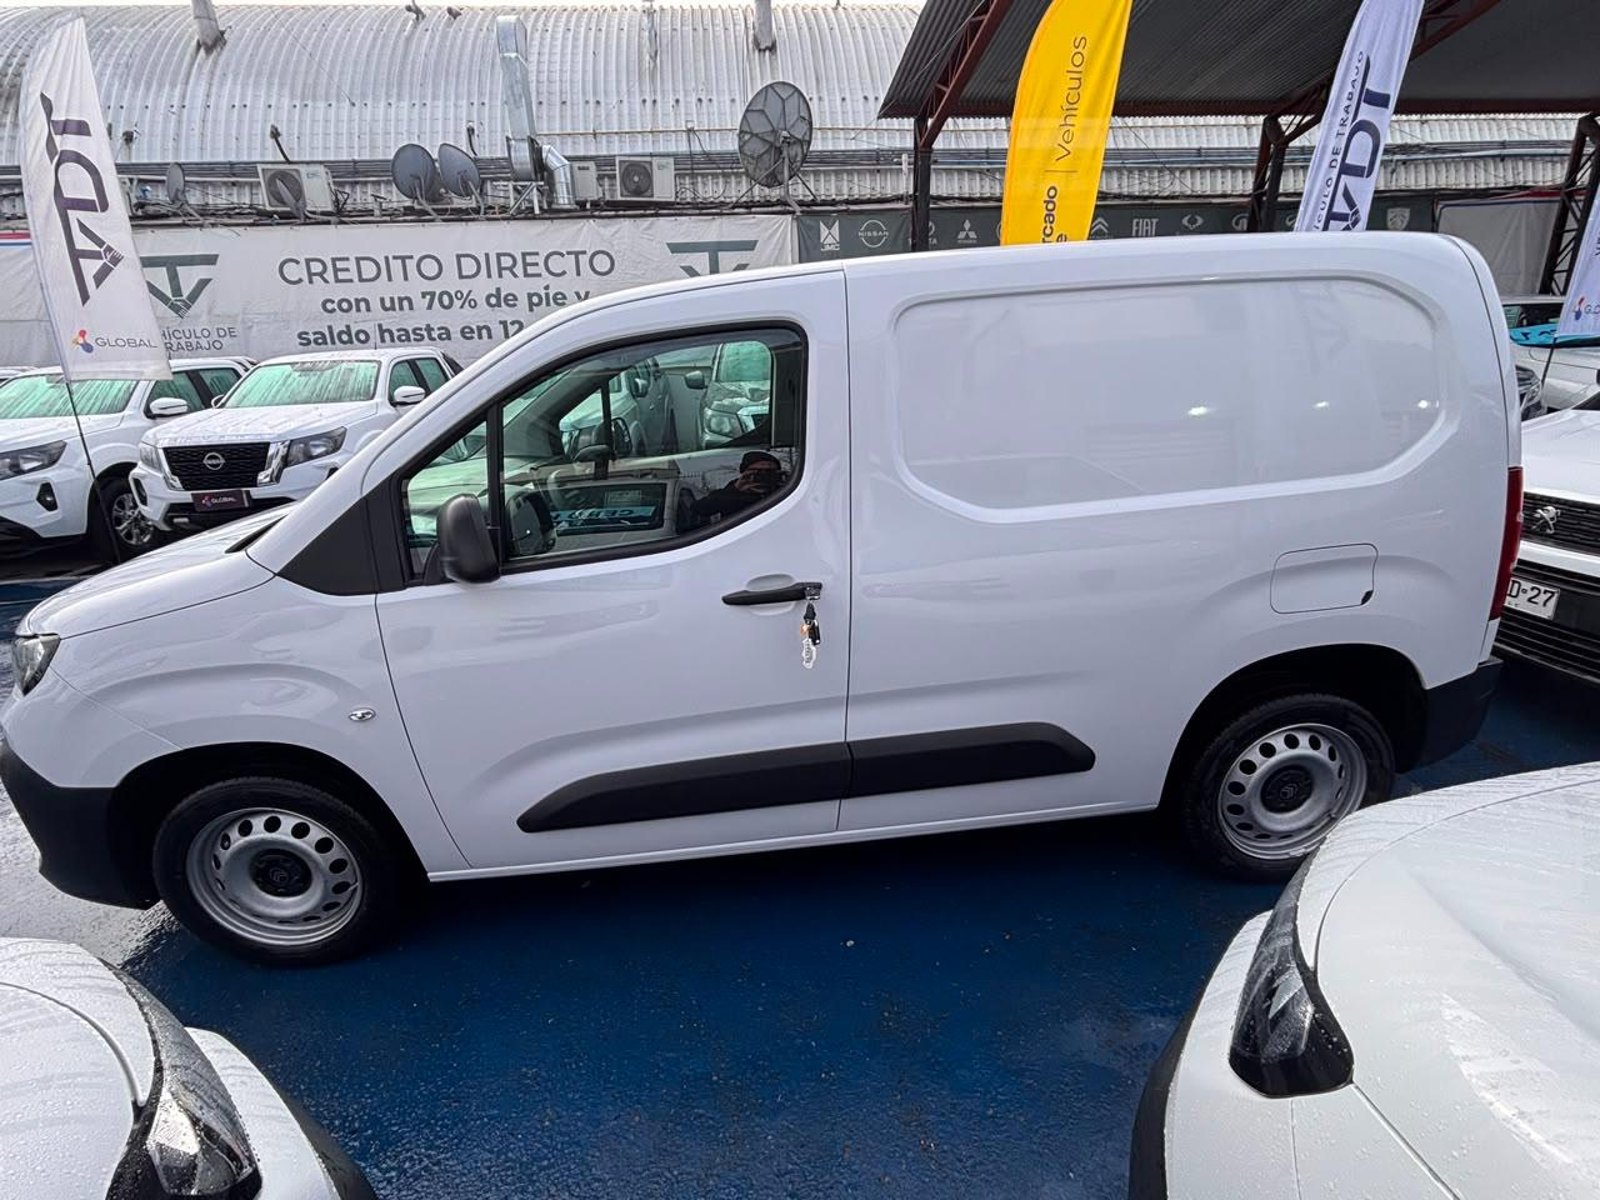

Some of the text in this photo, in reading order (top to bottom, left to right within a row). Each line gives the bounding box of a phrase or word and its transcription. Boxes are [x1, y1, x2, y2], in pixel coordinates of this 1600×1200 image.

[1055, 36, 1087, 162] Vehículos
[1335, 51, 1364, 139] TRABAJO
[1329, 146, 1342, 169] DE
[1041, 185, 1058, 243] rcado
[1132, 218, 1160, 237] FIAT
[278, 249, 616, 286] CREDITO DIRECTO
[321, 297, 372, 314] con
[379, 294, 414, 312] un
[420, 289, 479, 311] 70%
[485, 286, 518, 308] de
[94, 336, 158, 349] GLOBAL
[215, 326, 238, 339] DE
[296, 325, 371, 347] saldo
[377, 323, 452, 344] hasta
[459, 323, 493, 341] en
[163, 339, 224, 353] RABAJO
